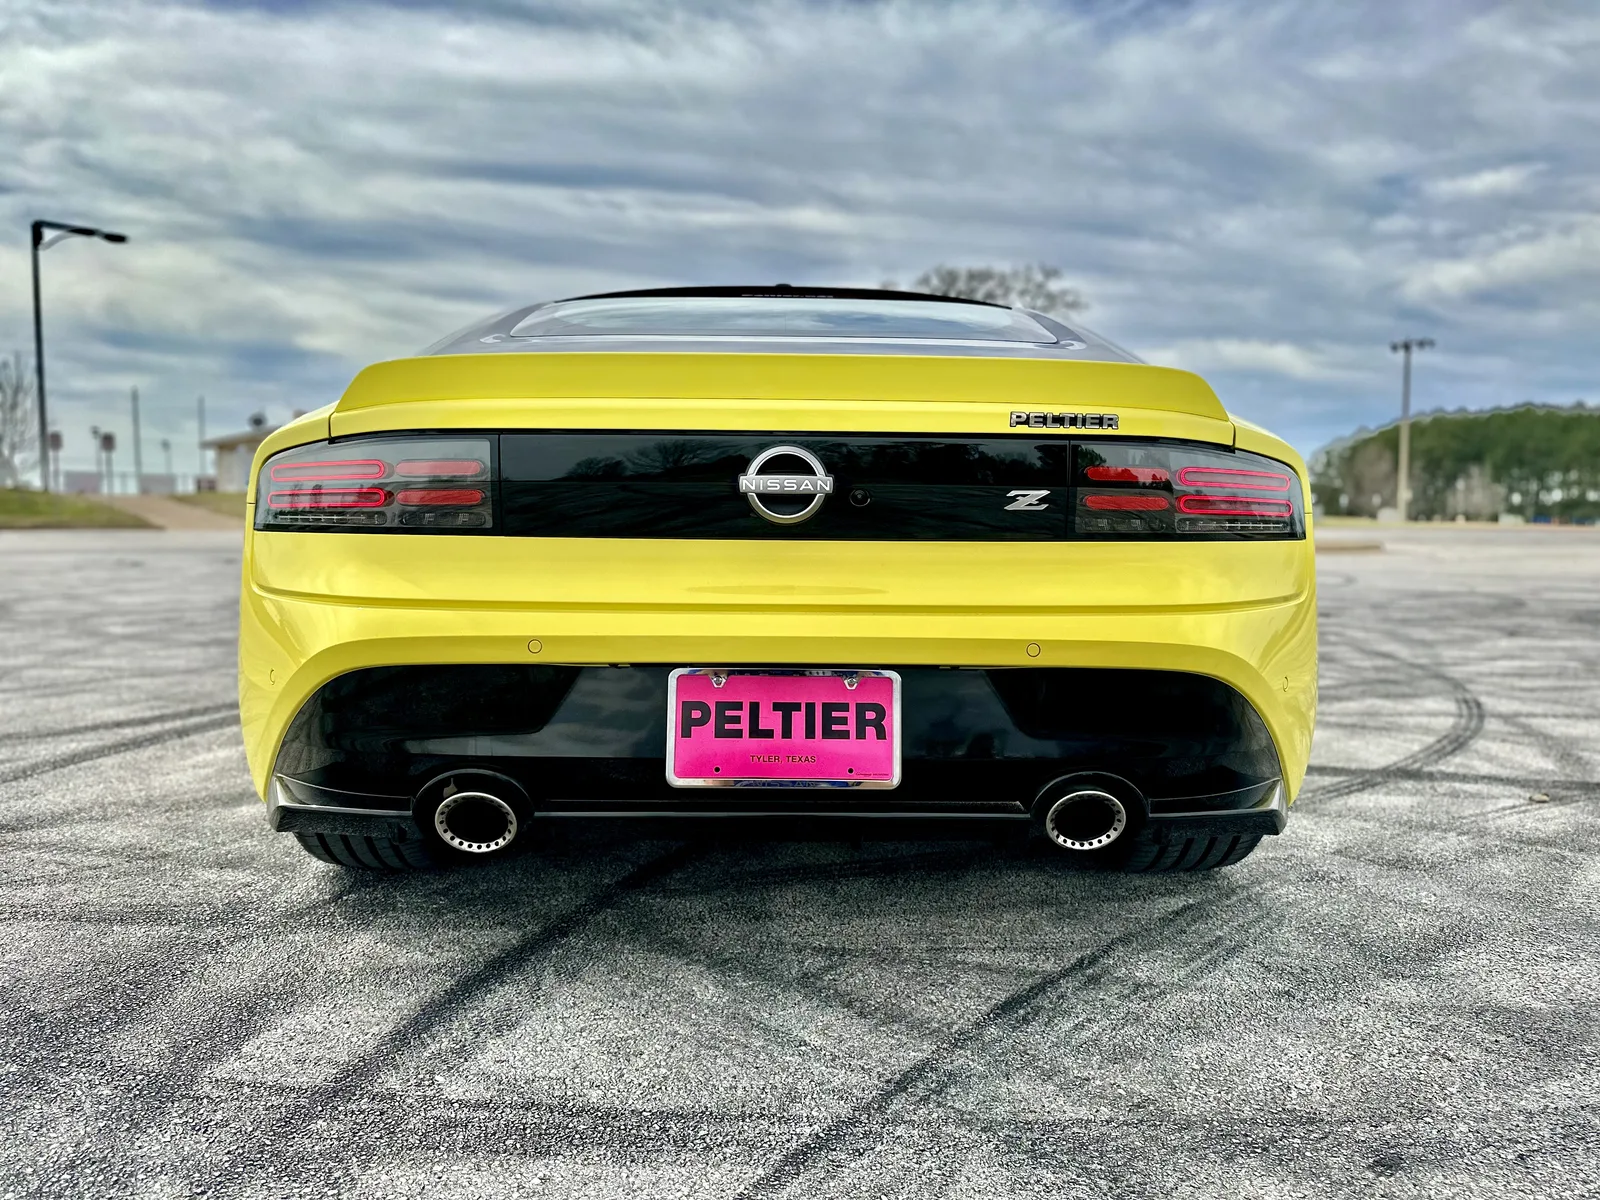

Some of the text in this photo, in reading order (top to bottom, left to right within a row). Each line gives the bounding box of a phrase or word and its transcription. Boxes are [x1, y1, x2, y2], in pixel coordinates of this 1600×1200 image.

[1010, 411, 1119, 429] PELTIER
[742, 479, 830, 491] NISSAN
[1004, 490, 1051, 511] Z
[680, 700, 887, 740] PELTIER
[750, 755, 816, 764] TYLER, TEXAS
